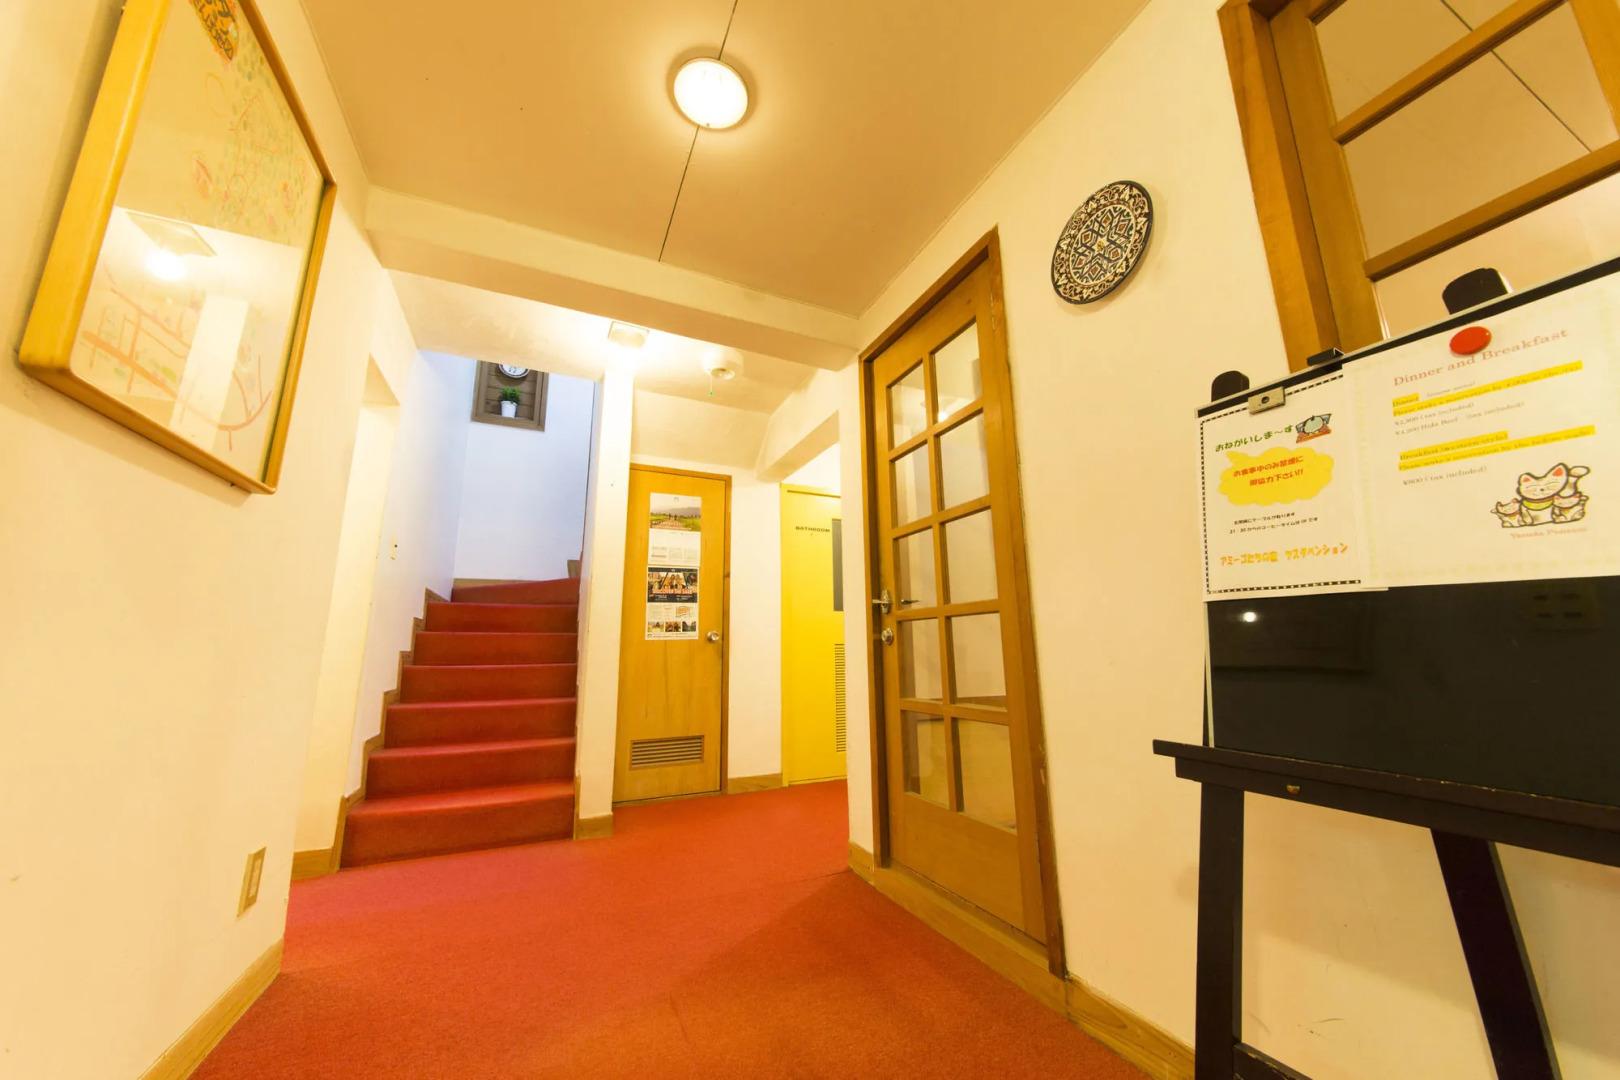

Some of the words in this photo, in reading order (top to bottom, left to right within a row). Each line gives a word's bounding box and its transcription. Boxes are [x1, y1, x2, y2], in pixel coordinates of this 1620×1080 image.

[1393, 366, 1442, 387] Dinner
[1447, 355, 1476, 372] and
[1481, 328, 1569, 361] Breakfast
[1446, 465, 1487, 479] included)
